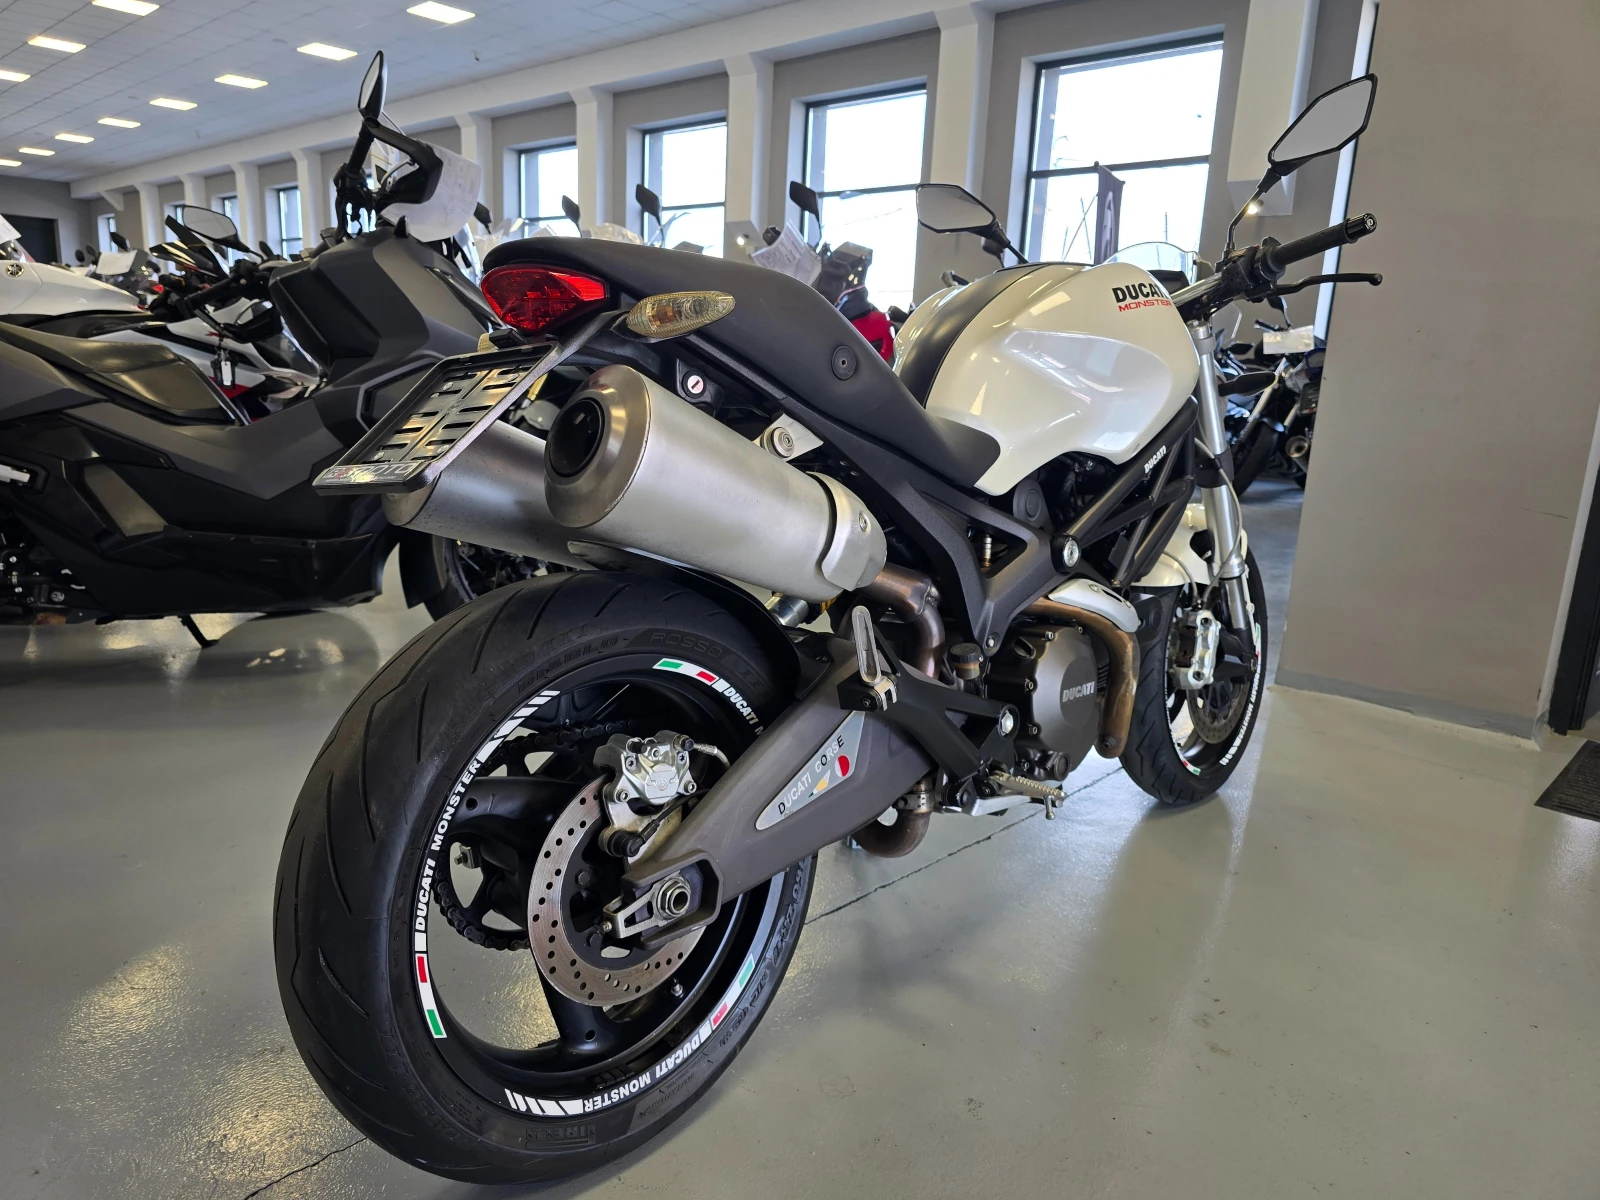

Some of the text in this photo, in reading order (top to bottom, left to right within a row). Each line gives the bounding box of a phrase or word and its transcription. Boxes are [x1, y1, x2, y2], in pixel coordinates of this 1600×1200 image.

[1118, 299, 1173, 312] MONSTER
[1144, 445, 1166, 473] DUCATI
[650, 632, 723, 658] ROSSO
[724, 687, 759, 725] DUCATI
[1062, 681, 1095, 703] DUCATI
[778, 735, 844, 815] DUCATI CORSE
[415, 761, 482, 931] DUCATI MONSTER
[655, 1033, 702, 1079] DUCATI
[584, 1071, 652, 1113] MONSTER
